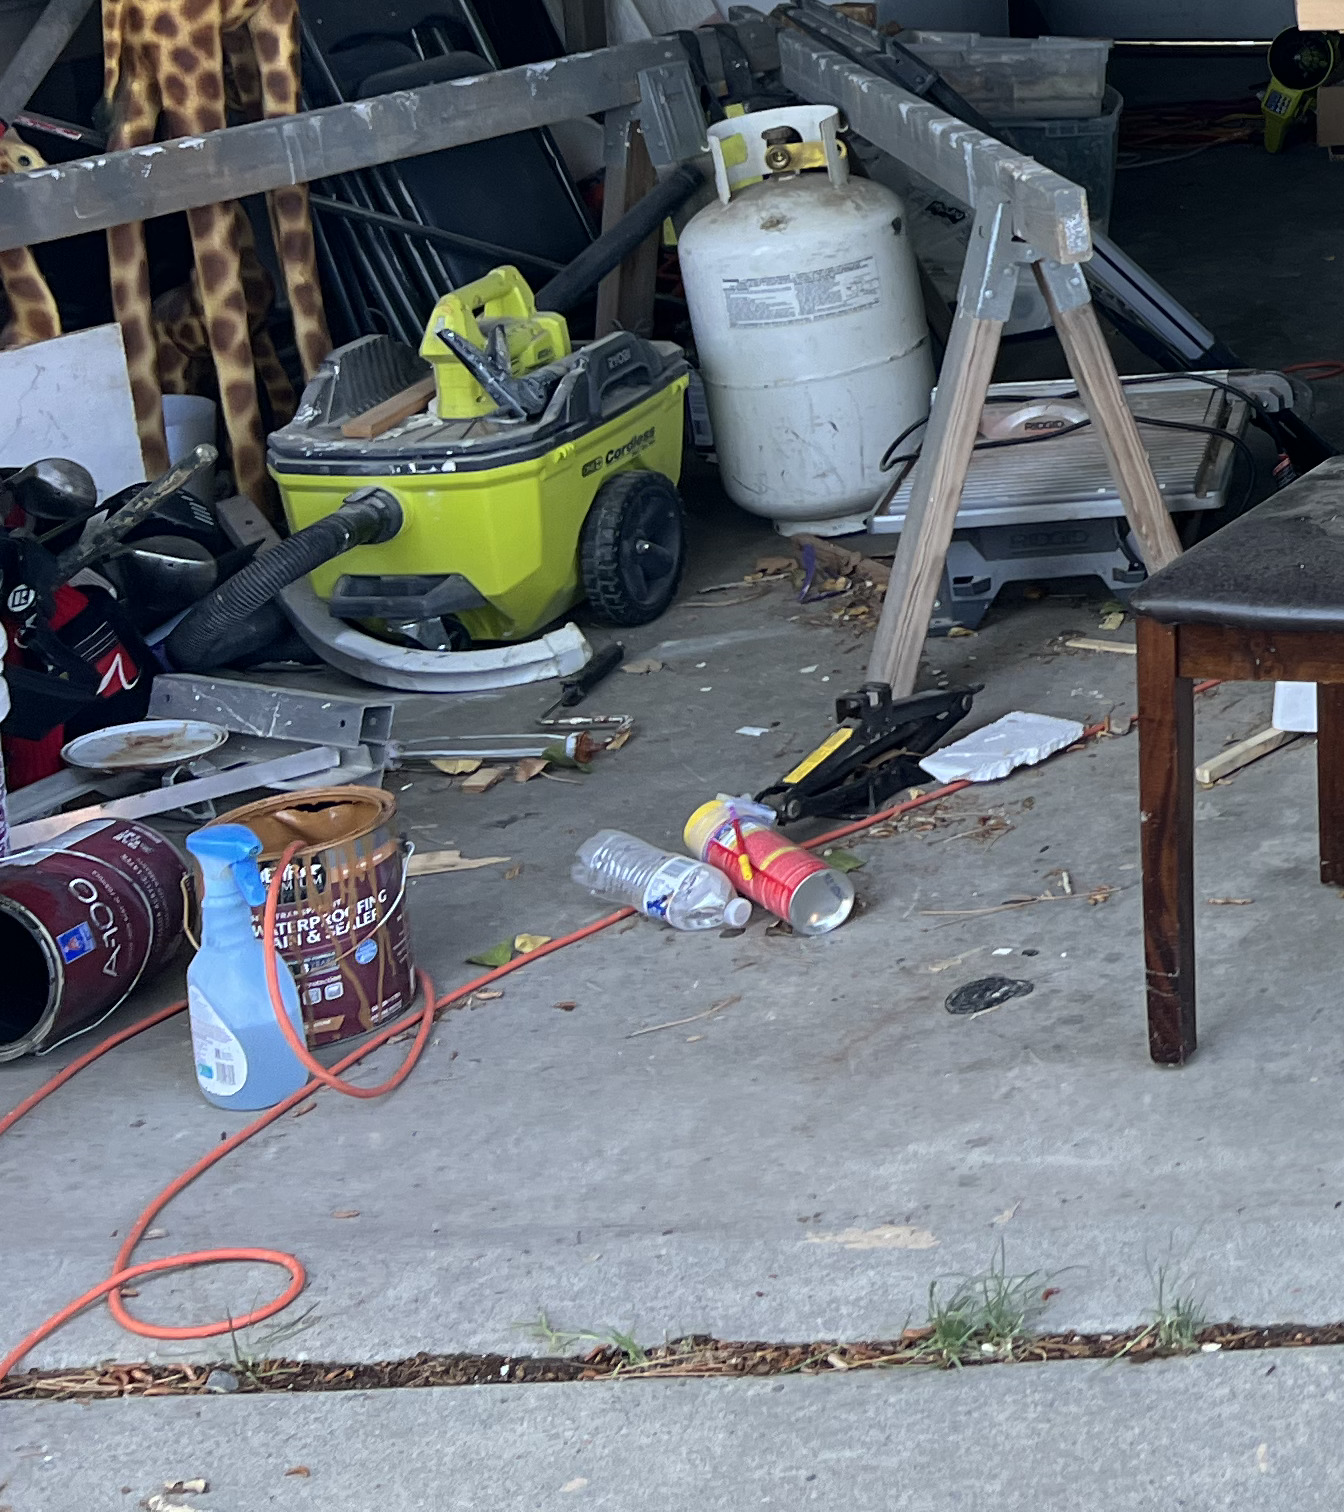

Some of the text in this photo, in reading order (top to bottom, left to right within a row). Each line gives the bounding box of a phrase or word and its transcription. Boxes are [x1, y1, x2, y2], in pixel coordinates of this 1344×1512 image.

[1024, 420, 1065, 431] RIDGID
[605, 427, 656, 465] Cordless
[306, 929, 321, 944] &
